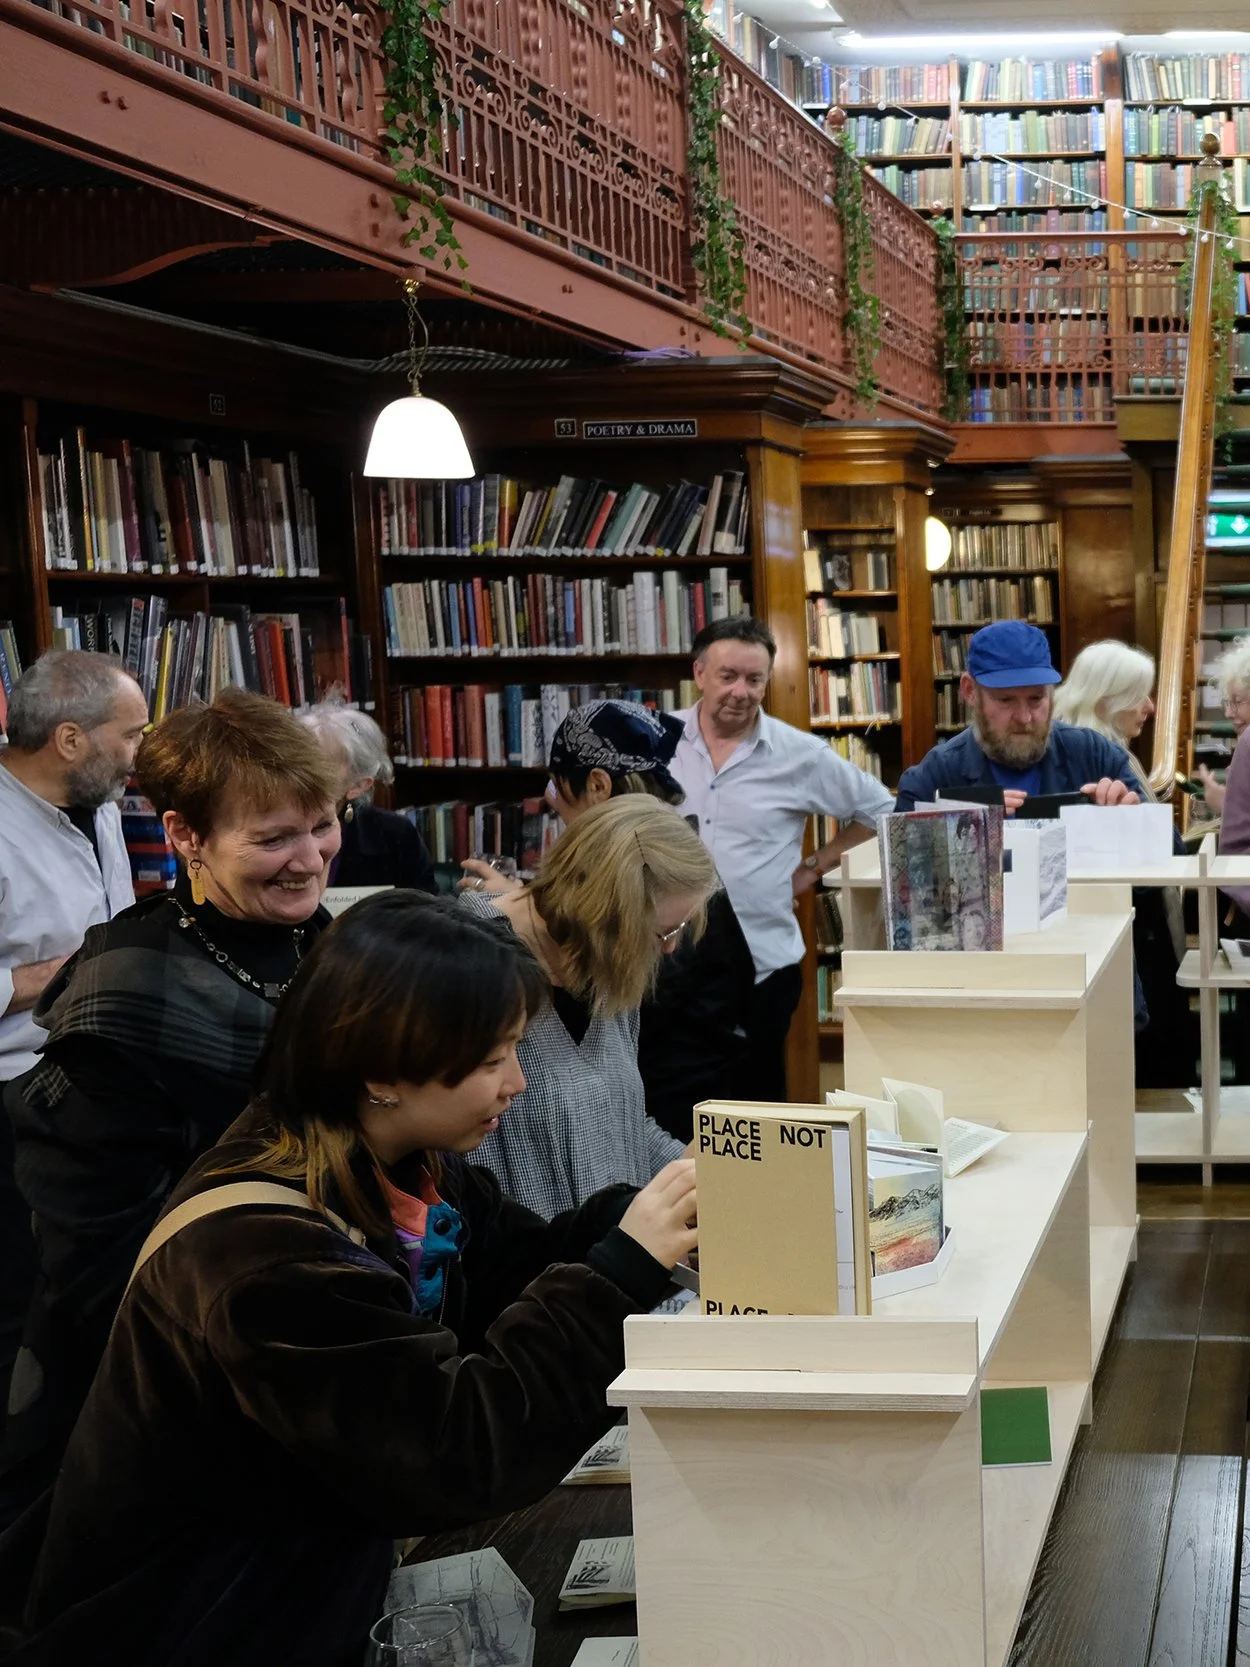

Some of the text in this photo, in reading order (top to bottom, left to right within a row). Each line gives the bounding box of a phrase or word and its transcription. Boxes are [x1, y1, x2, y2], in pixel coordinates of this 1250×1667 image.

[560, 423, 572, 434] 53
[587, 423, 693, 436] POETRY & DRAMA
[699, 1114, 826, 1148] PLACE NOT
[700, 1135, 762, 1161] PLACE
